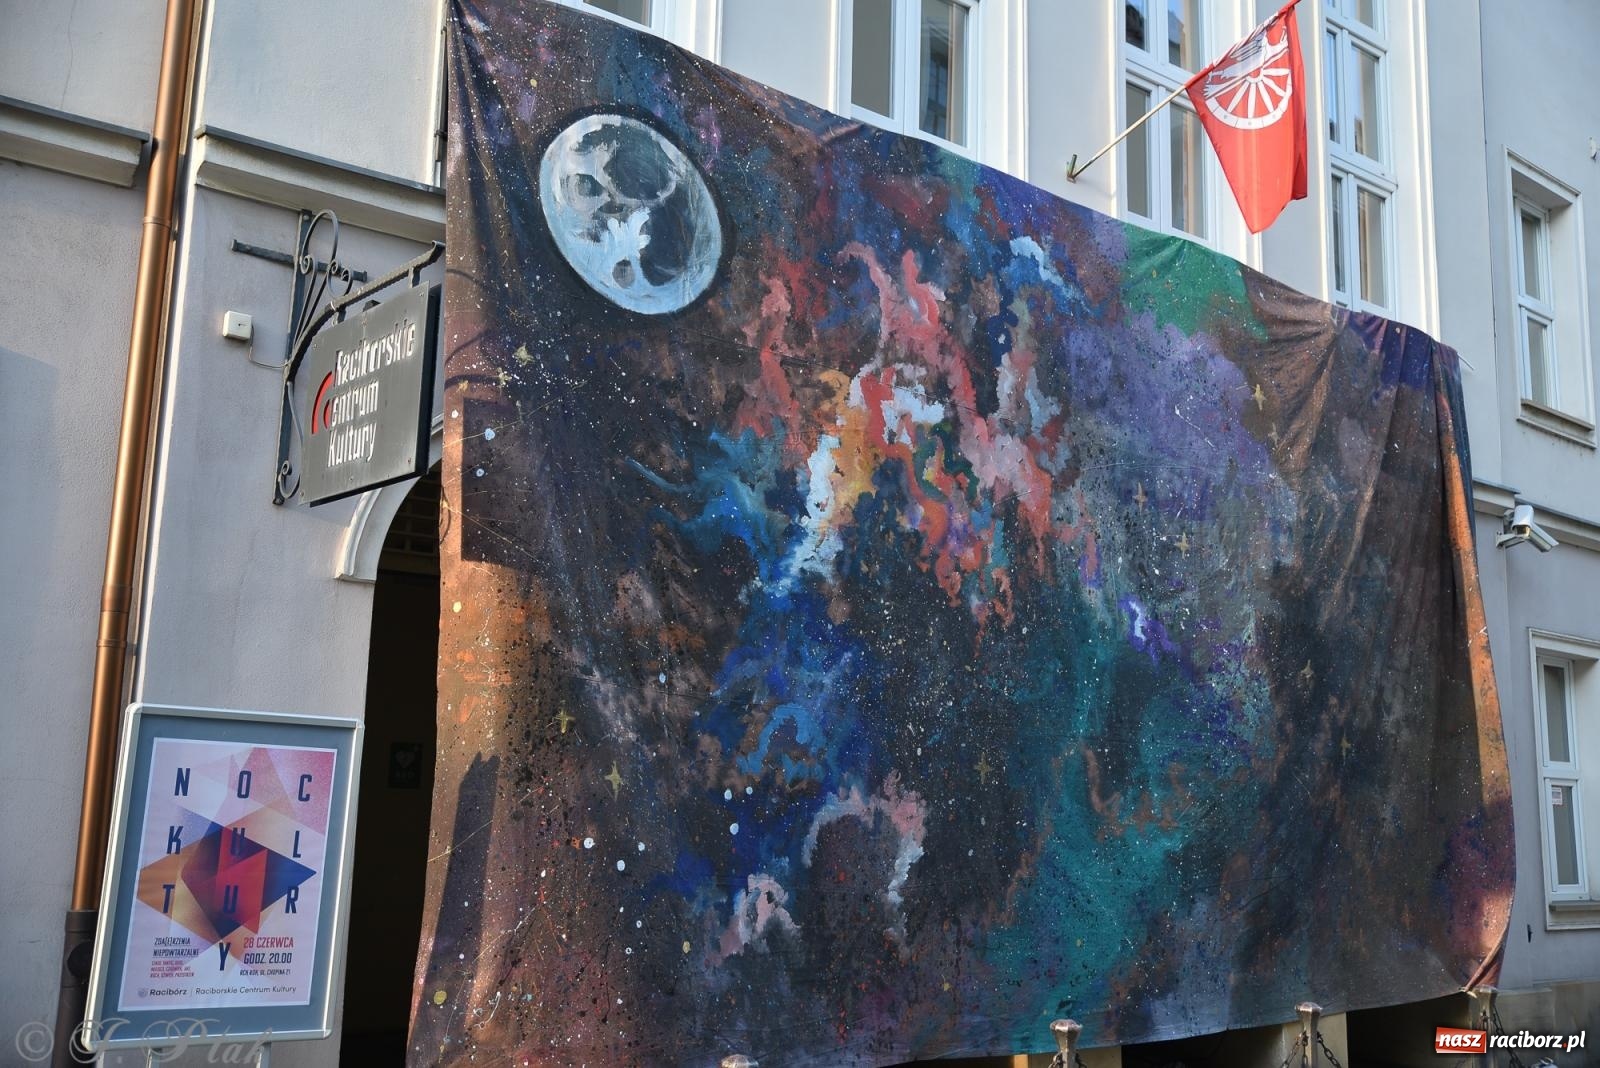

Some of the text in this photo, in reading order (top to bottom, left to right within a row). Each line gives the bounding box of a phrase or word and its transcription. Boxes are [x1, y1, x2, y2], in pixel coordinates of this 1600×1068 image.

[335, 319, 416, 387] Raciborskie
[327, 422, 377, 468] Kultury
[244, 937, 294, 948] 28 CZERWCA
[269, 952, 292, 963] 20.00
[150, 986, 297, 996] Racibórz Raciborskie Centrum Kultury
